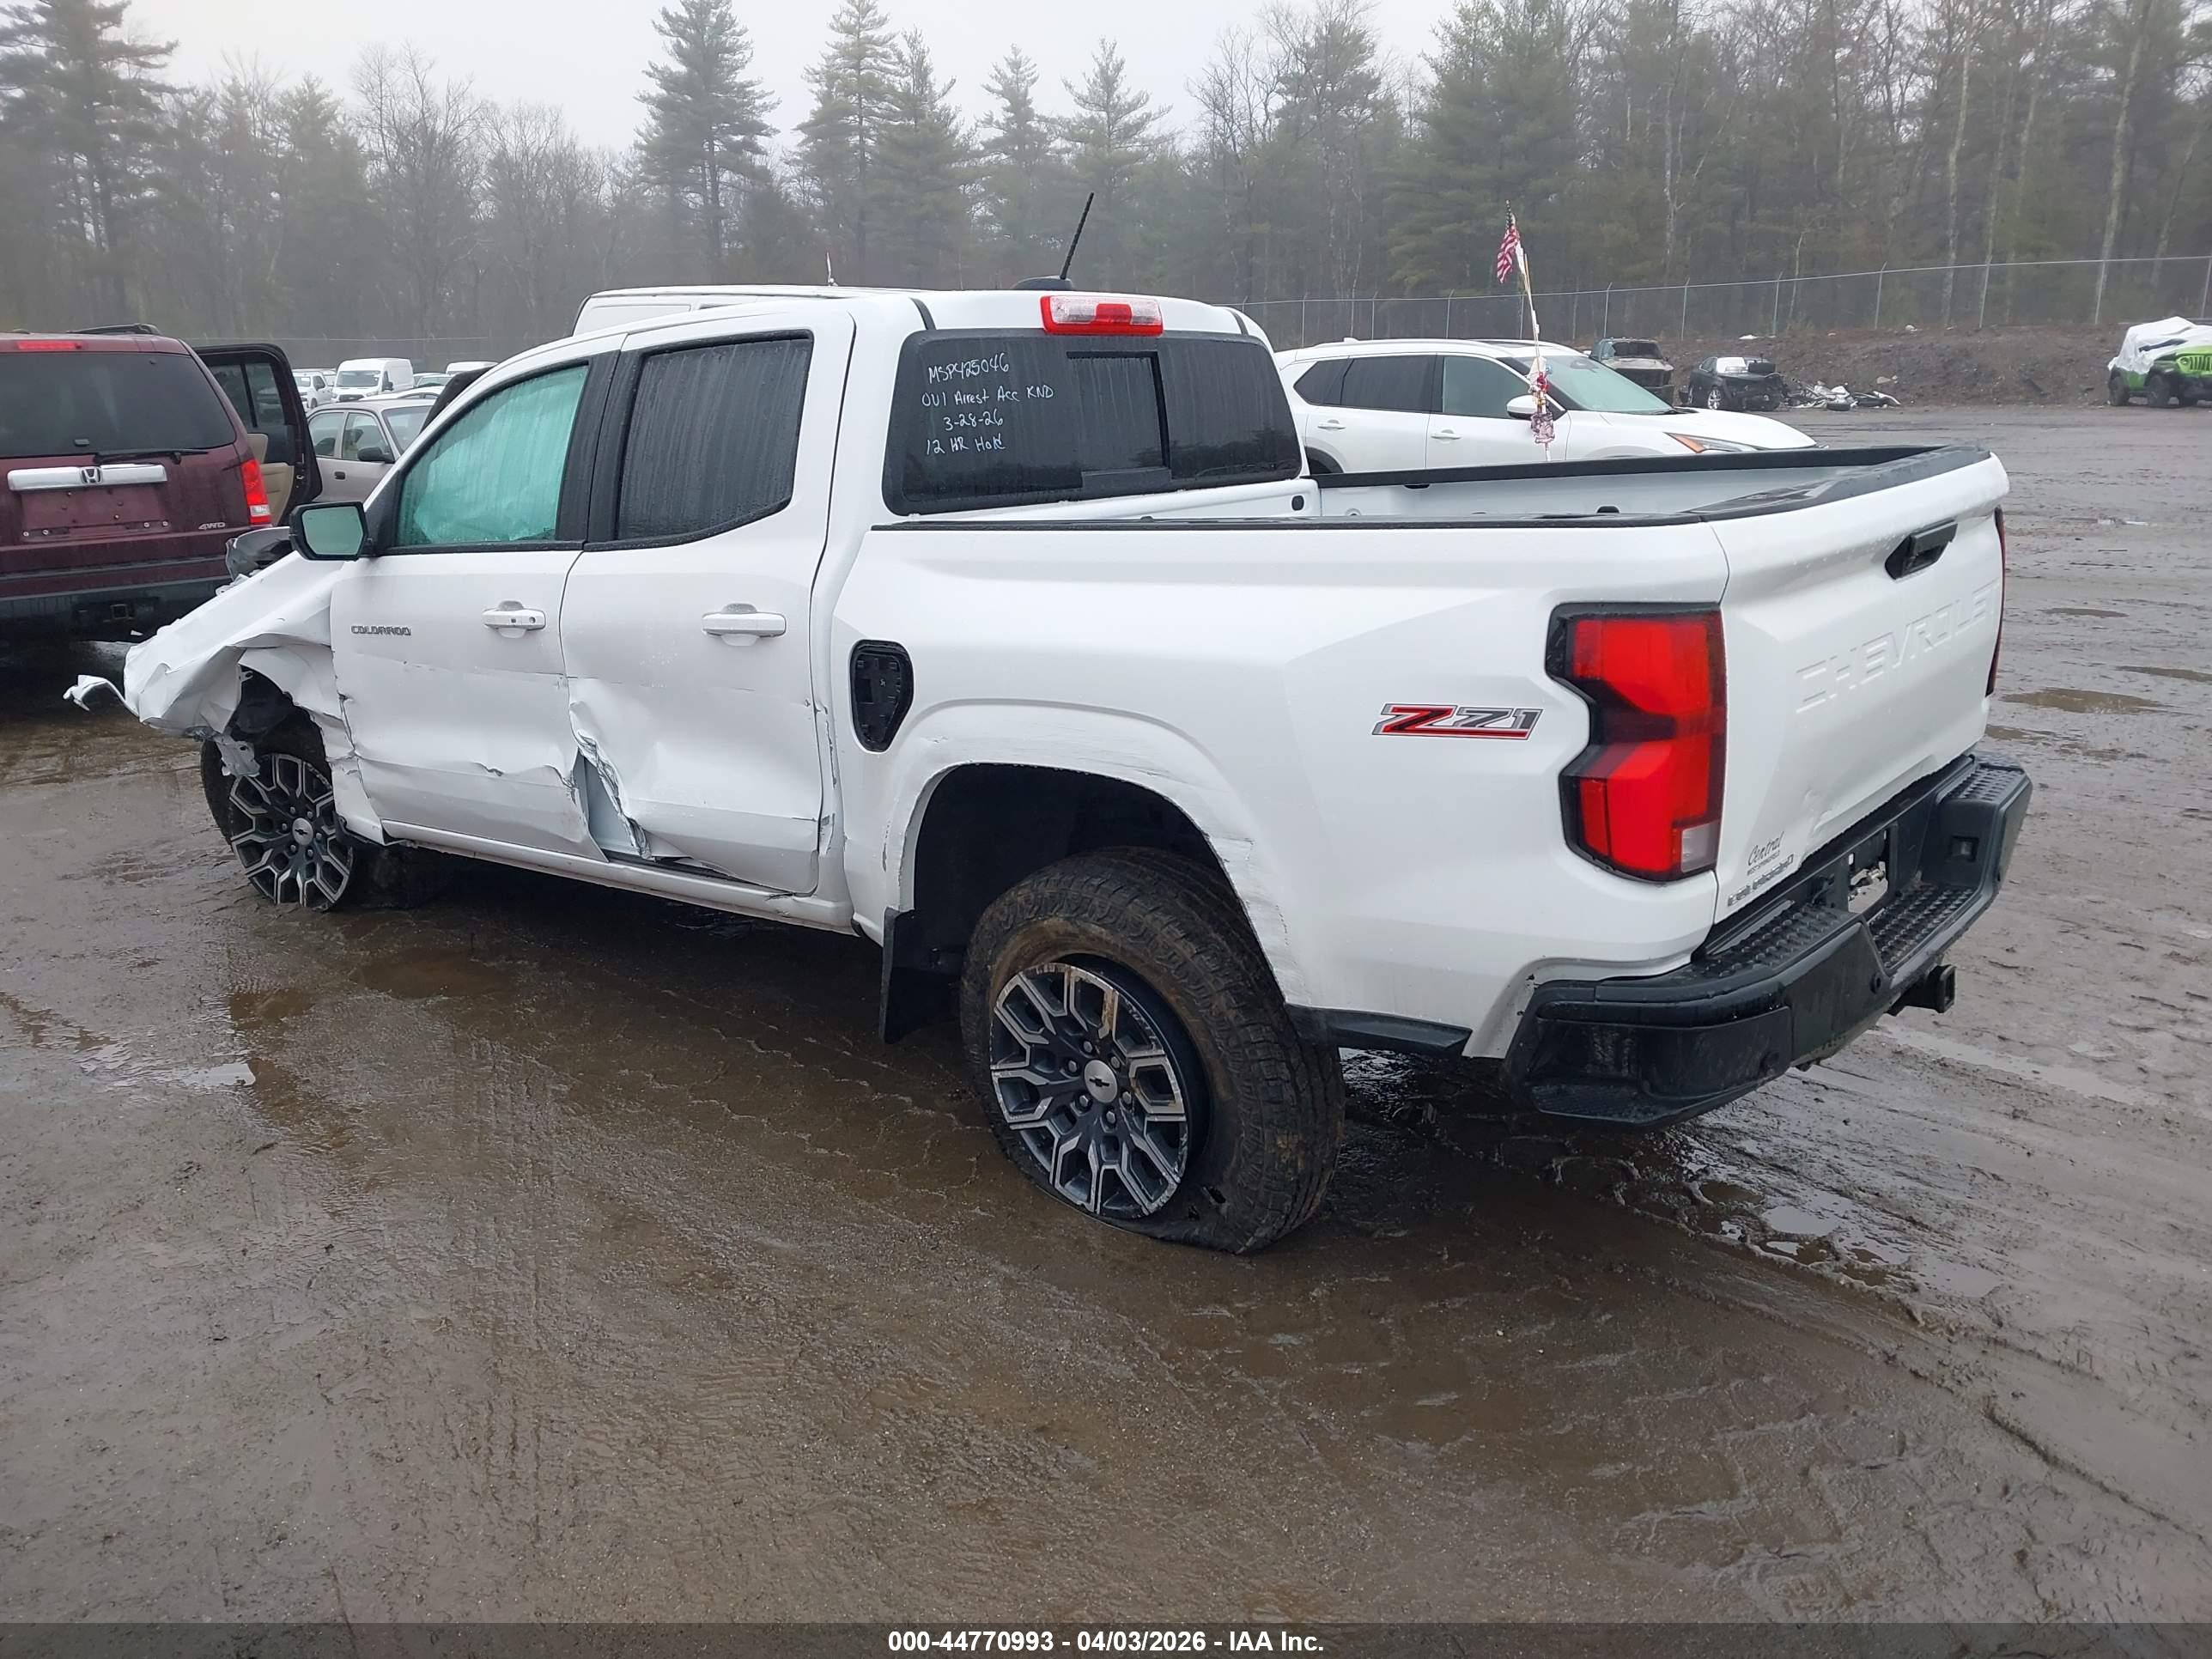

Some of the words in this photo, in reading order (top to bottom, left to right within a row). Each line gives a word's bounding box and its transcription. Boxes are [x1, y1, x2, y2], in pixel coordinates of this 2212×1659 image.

[954, 388, 989, 405] Arrest
[944, 409, 1004, 430] 3-28-26
[927, 439, 945, 455] 12
[198, 521, 226, 530] 4WD
[350, 625, 411, 636] COLORADO
[1371, 702, 1544, 740] Z71
